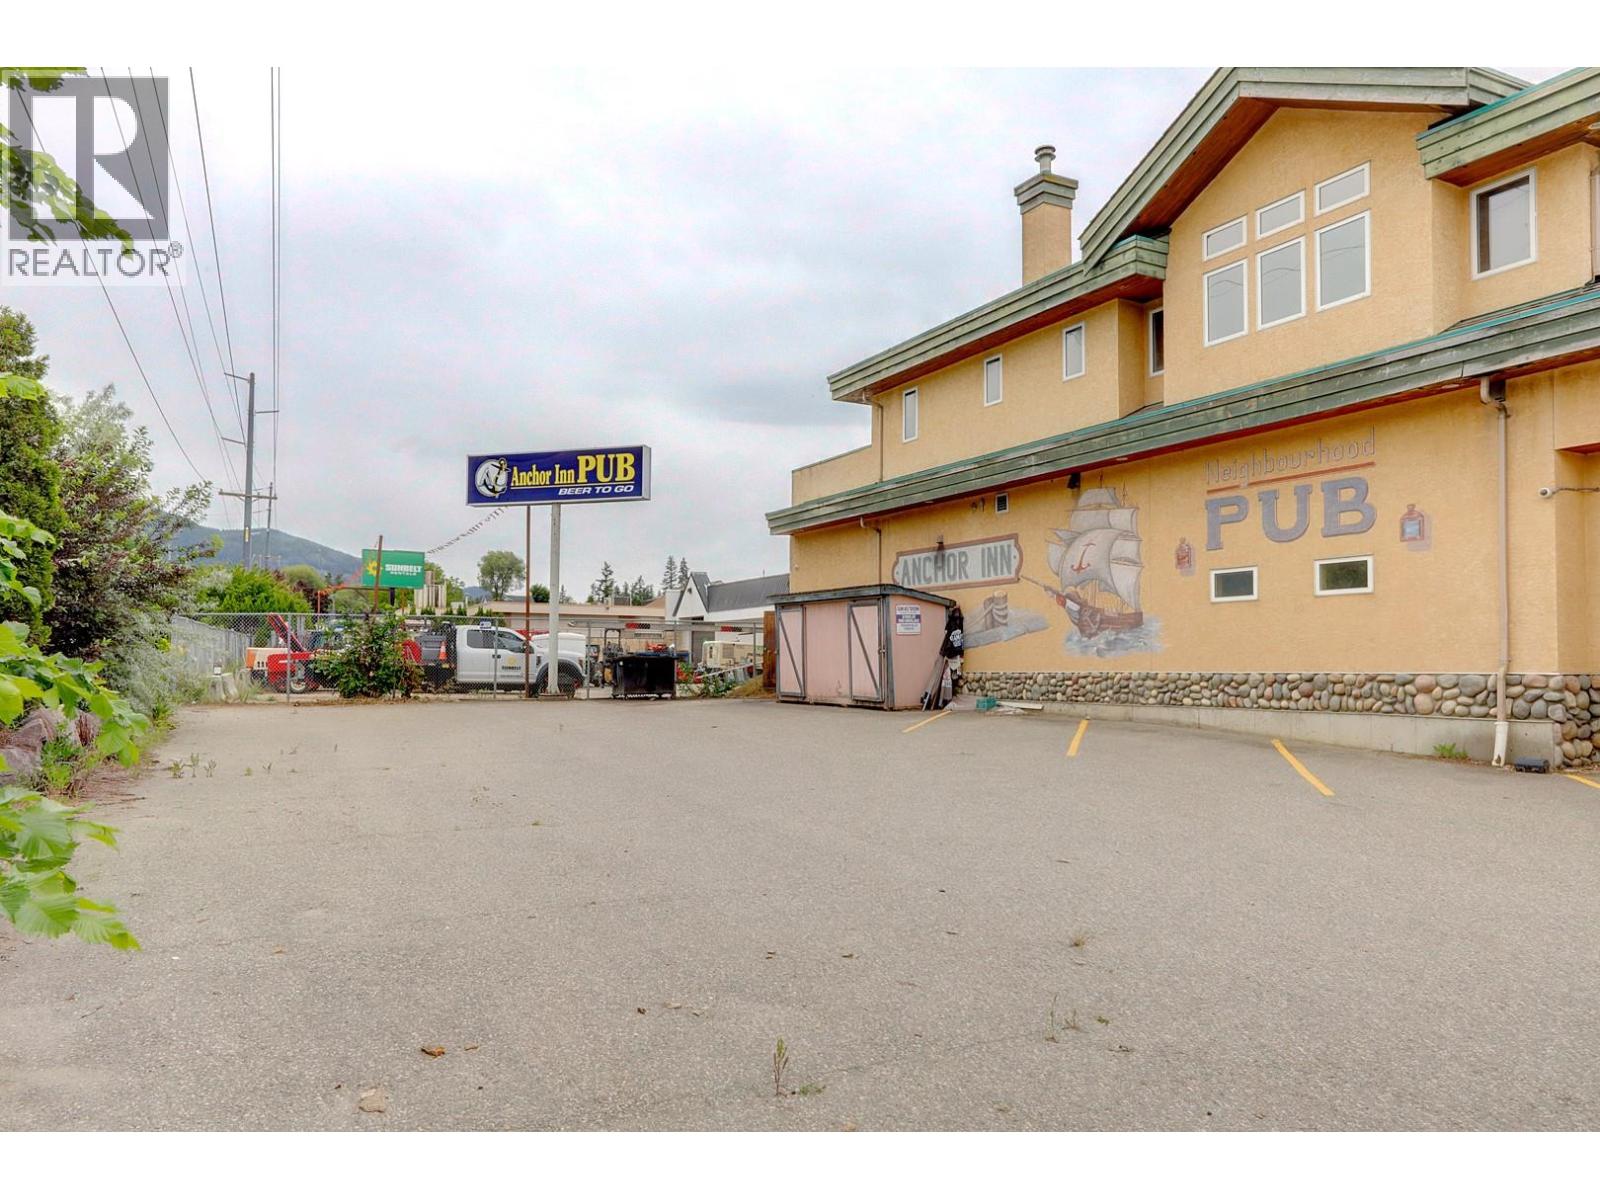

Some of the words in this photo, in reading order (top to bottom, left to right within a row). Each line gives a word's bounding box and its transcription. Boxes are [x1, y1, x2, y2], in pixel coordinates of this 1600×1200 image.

[511, 464, 551, 487] Anchor
[554, 464, 575, 485] Inn
[577, 453, 635, 484] PUB
[1204, 424, 1376, 488] Neighbourhood
[558, 486, 591, 496] BEER
[595, 486, 612, 494] TO
[614, 485, 635, 493] GO
[1205, 476, 1378, 551] PUB
[901, 551, 969, 586] ANCHOR
[981, 544, 1012, 578] INN
